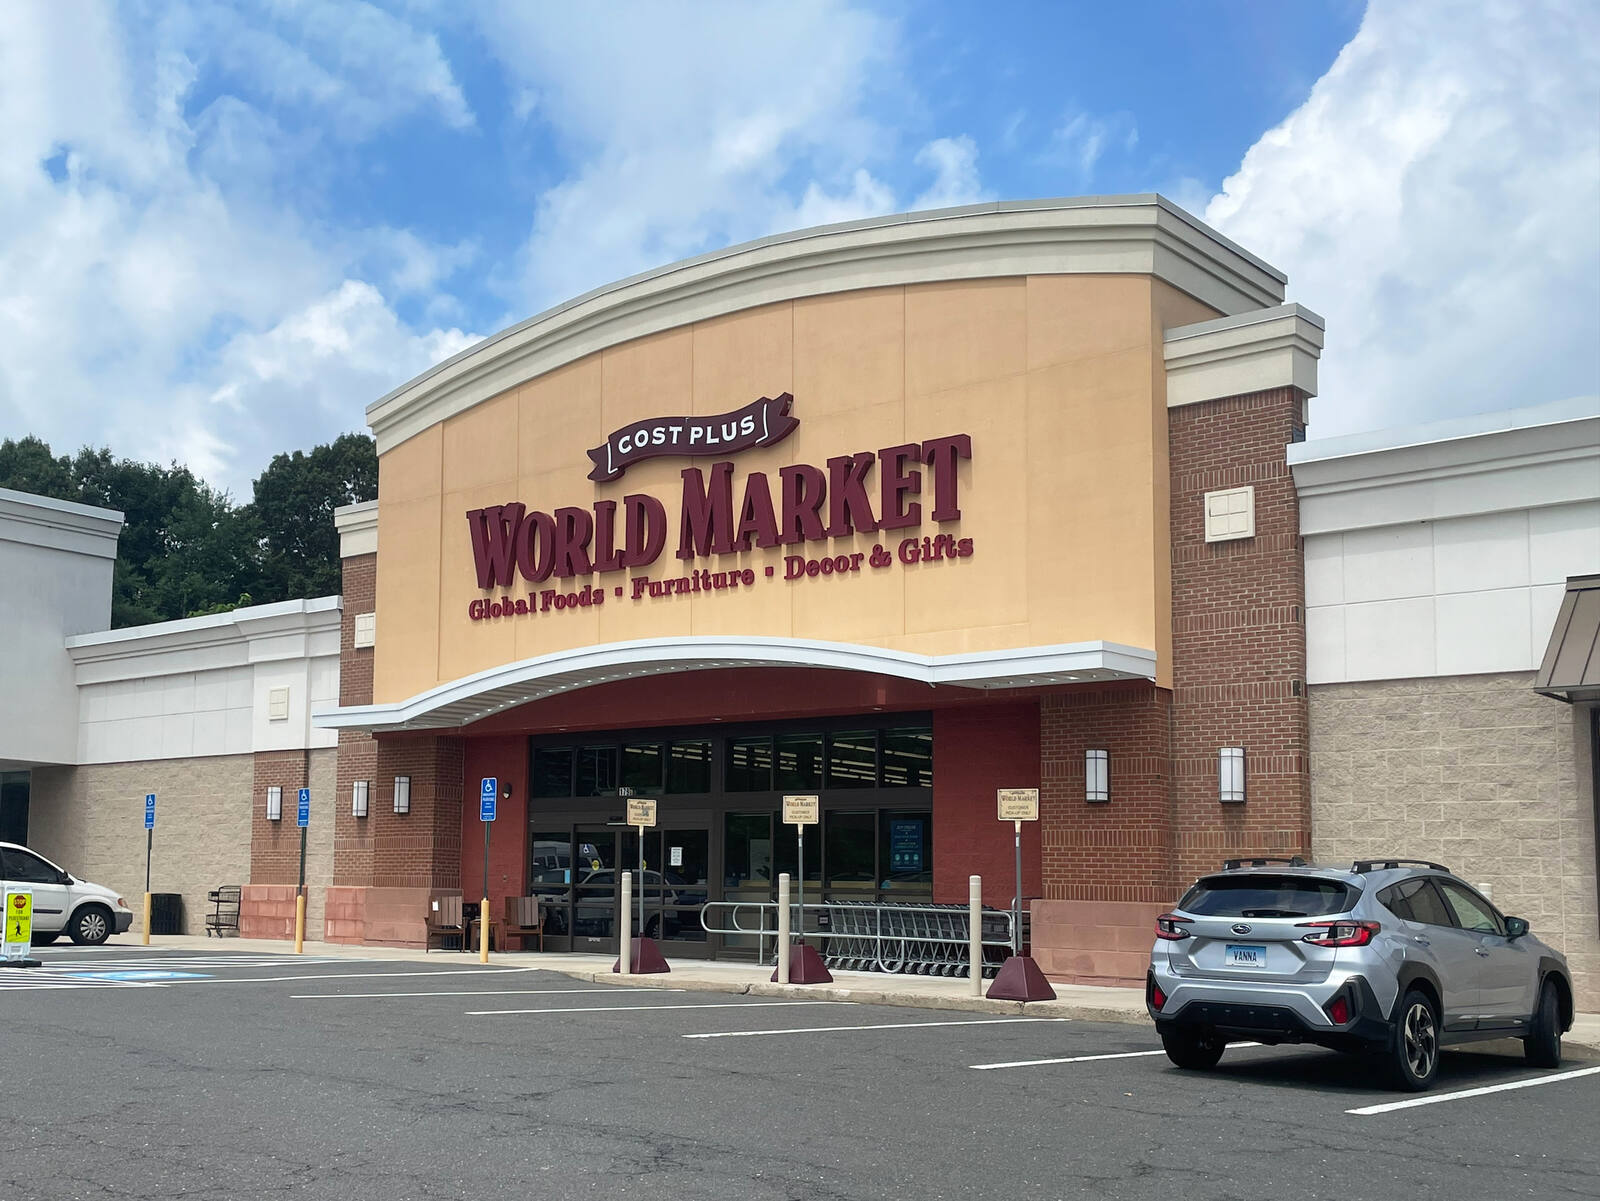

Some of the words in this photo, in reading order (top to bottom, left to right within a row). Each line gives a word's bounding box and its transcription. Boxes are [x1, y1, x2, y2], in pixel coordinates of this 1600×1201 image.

[617, 425, 682, 454] COST
[689, 415, 755, 445] PLUS
[465, 492, 667, 590] WORLD
[675, 433, 972, 561] MARKET
[468, 591, 537, 620] Global
[540, 585, 604, 612] Foods
[630, 567, 755, 600] Furniture
[784, 552, 864, 580] Decor
[869, 543, 892, 568] &
[898, 533, 974, 564] Gifts
[1234, 951, 1256, 961] VANNA
